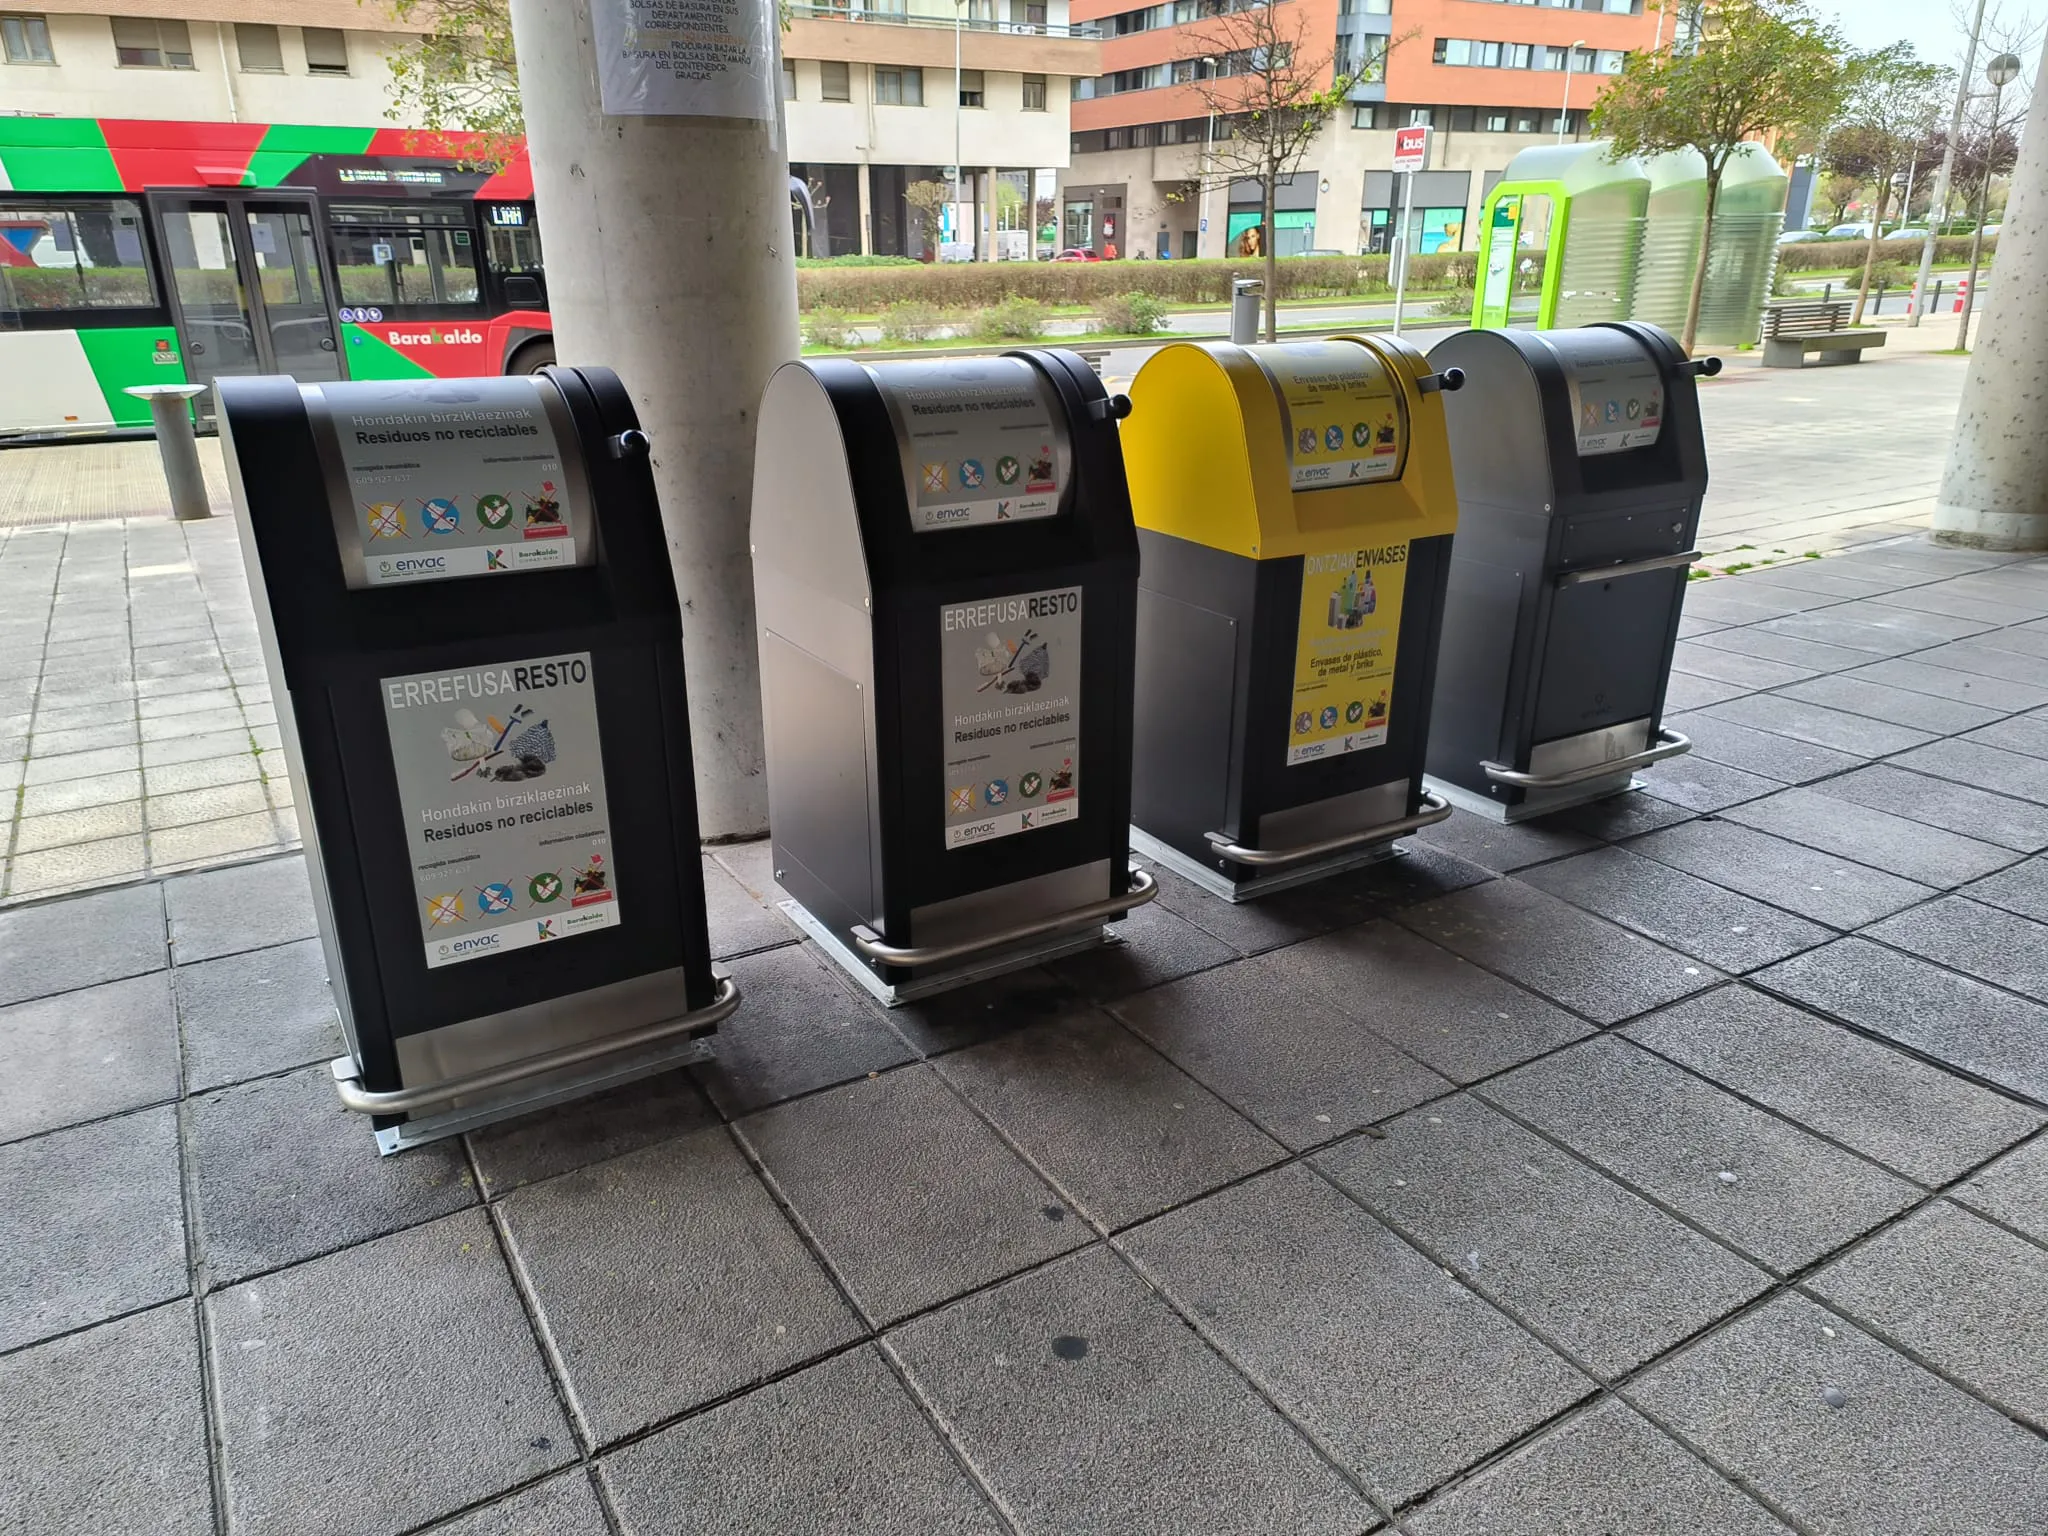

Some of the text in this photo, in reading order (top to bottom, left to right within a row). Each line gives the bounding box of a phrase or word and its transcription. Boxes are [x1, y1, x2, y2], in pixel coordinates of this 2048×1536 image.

[651, 10, 723, 23] DEPARTAMENTOS
[666, 1, 677, 10] DE
[679, 2, 711, 12] BASURA
[712, 4, 723, 13] EN
[724, 6, 739, 16] SUS
[659, 51, 671, 59] EN
[673, 51, 705, 61] BOLSAS
[706, 53, 720, 62] DEL
[671, 41, 712, 51] PROCURAR
[739, 46, 746, 54] LA
[655, 61, 672, 70] DEL
[388, 327, 482, 345] Barakaldo
[911, 397, 1036, 416] Residuos no reciclables
[352, 407, 532, 427] Hondakin birziklaezinak
[355, 423, 538, 445] Residuos no reciclables
[542, 463, 558, 472] 010
[937, 507, 970, 519] envac
[518, 548, 558, 558] Barakaldo
[395, 556, 446, 571] envac
[1310, 655, 1340, 669] Envases
[1342, 652, 1352, 662] de
[1353, 648, 1383, 663] plástico,
[1317, 667, 1327, 677] de
[1328, 663, 1349, 675] metal
[1350, 663, 1356, 673] y
[1356, 659, 1375, 670] briks
[954, 695, 1070, 727] Hondakin birziklaezinak
[954, 712, 1070, 744] Residuos no reciclables
[421, 781, 591, 823] Hondakin birziklaezinak
[423, 801, 594, 843] Residuos no reciclables
[964, 821, 996, 837] envac
[453, 933, 500, 951] envac
